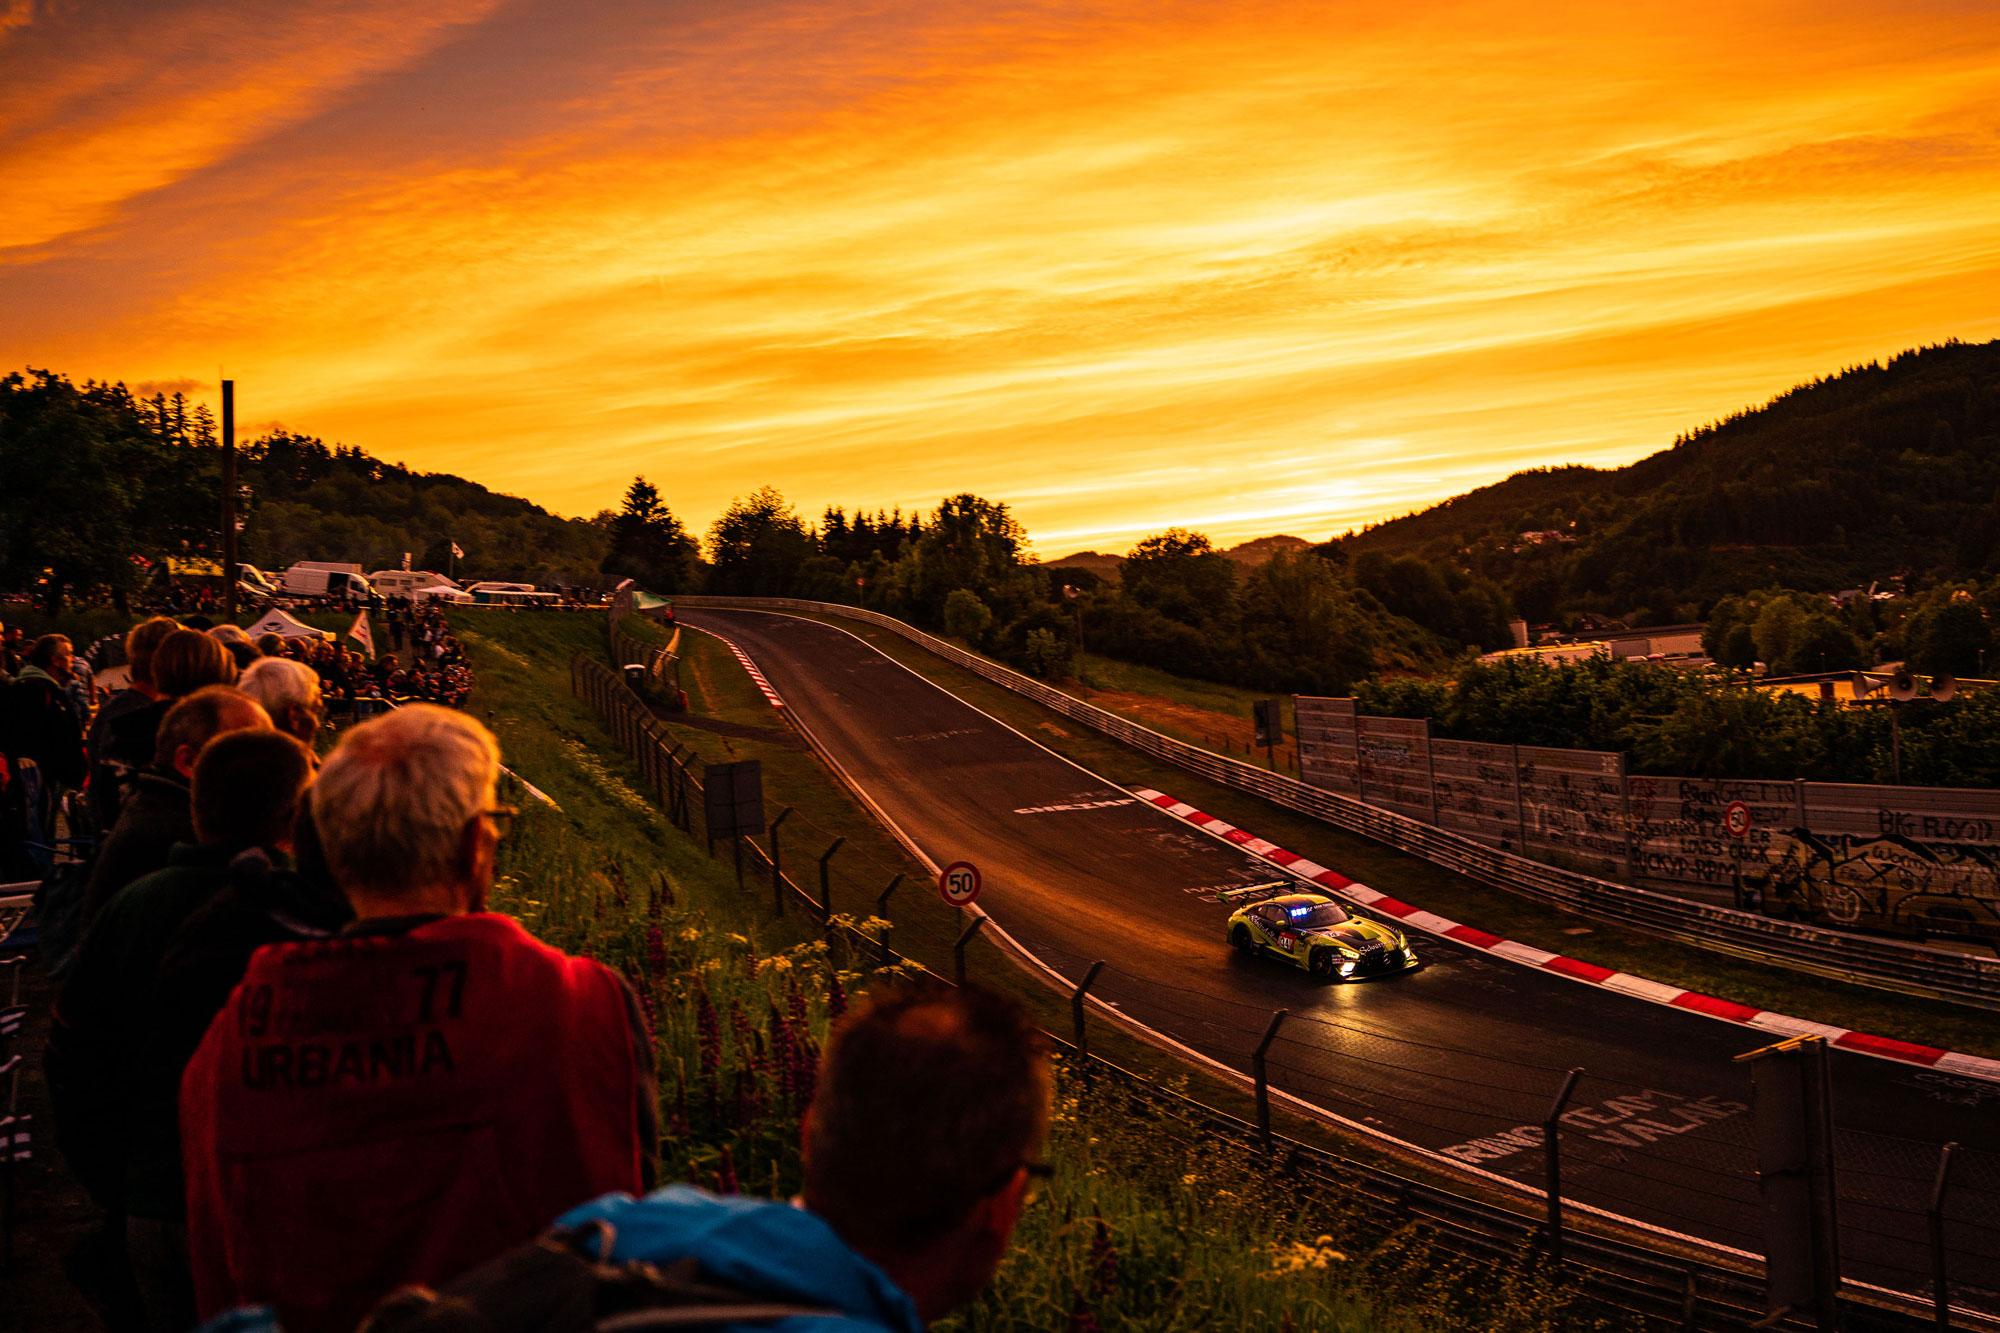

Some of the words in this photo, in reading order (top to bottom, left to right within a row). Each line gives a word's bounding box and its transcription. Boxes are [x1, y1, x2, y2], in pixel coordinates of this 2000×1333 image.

[1878, 809, 1917, 838] BIG
[1922, 816, 1993, 842] FLOOD
[949, 872, 973, 895] 50
[414, 959, 467, 1025] 77
[242, 1030, 458, 1089] URBANIA
